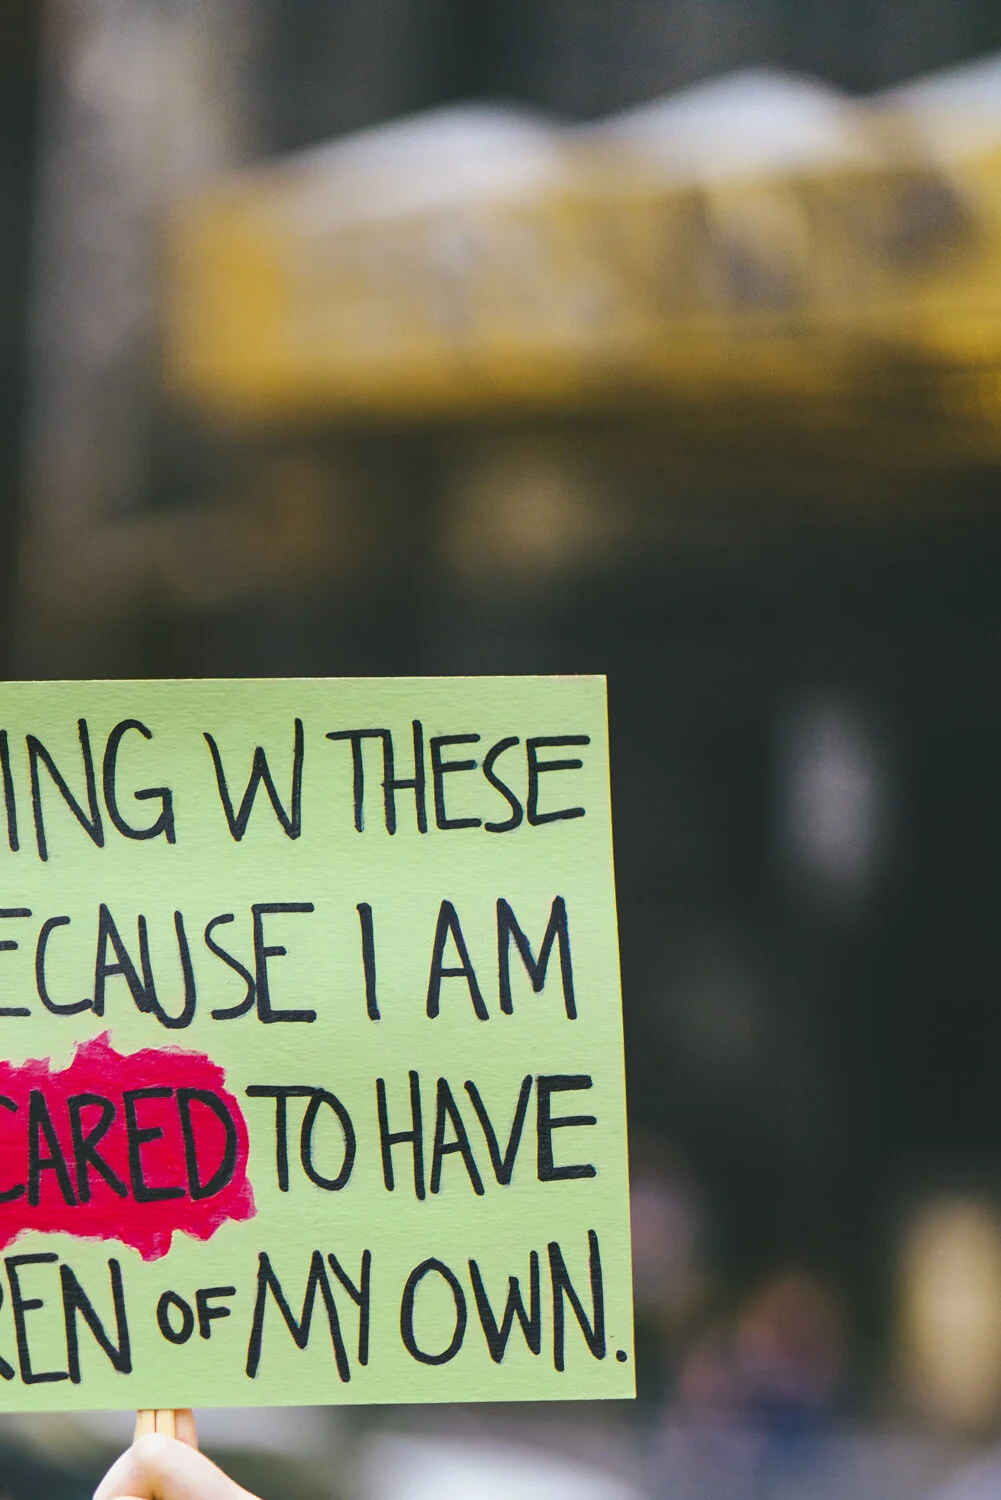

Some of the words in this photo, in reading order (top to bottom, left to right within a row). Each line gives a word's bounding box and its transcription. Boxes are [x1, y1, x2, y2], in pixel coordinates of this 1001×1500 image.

[202, 717, 304, 842] W
[325, 719, 591, 836] THESE
[356, 902, 381, 1021] I
[427, 895, 578, 1021] AM
[245, 1085, 357, 1193] TO
[376, 1070, 597, 1201] HAVE
[156, 1286, 237, 1345] OF
[245, 1249, 372, 1383] MY
[400, 1229, 629, 1372] OWN.
